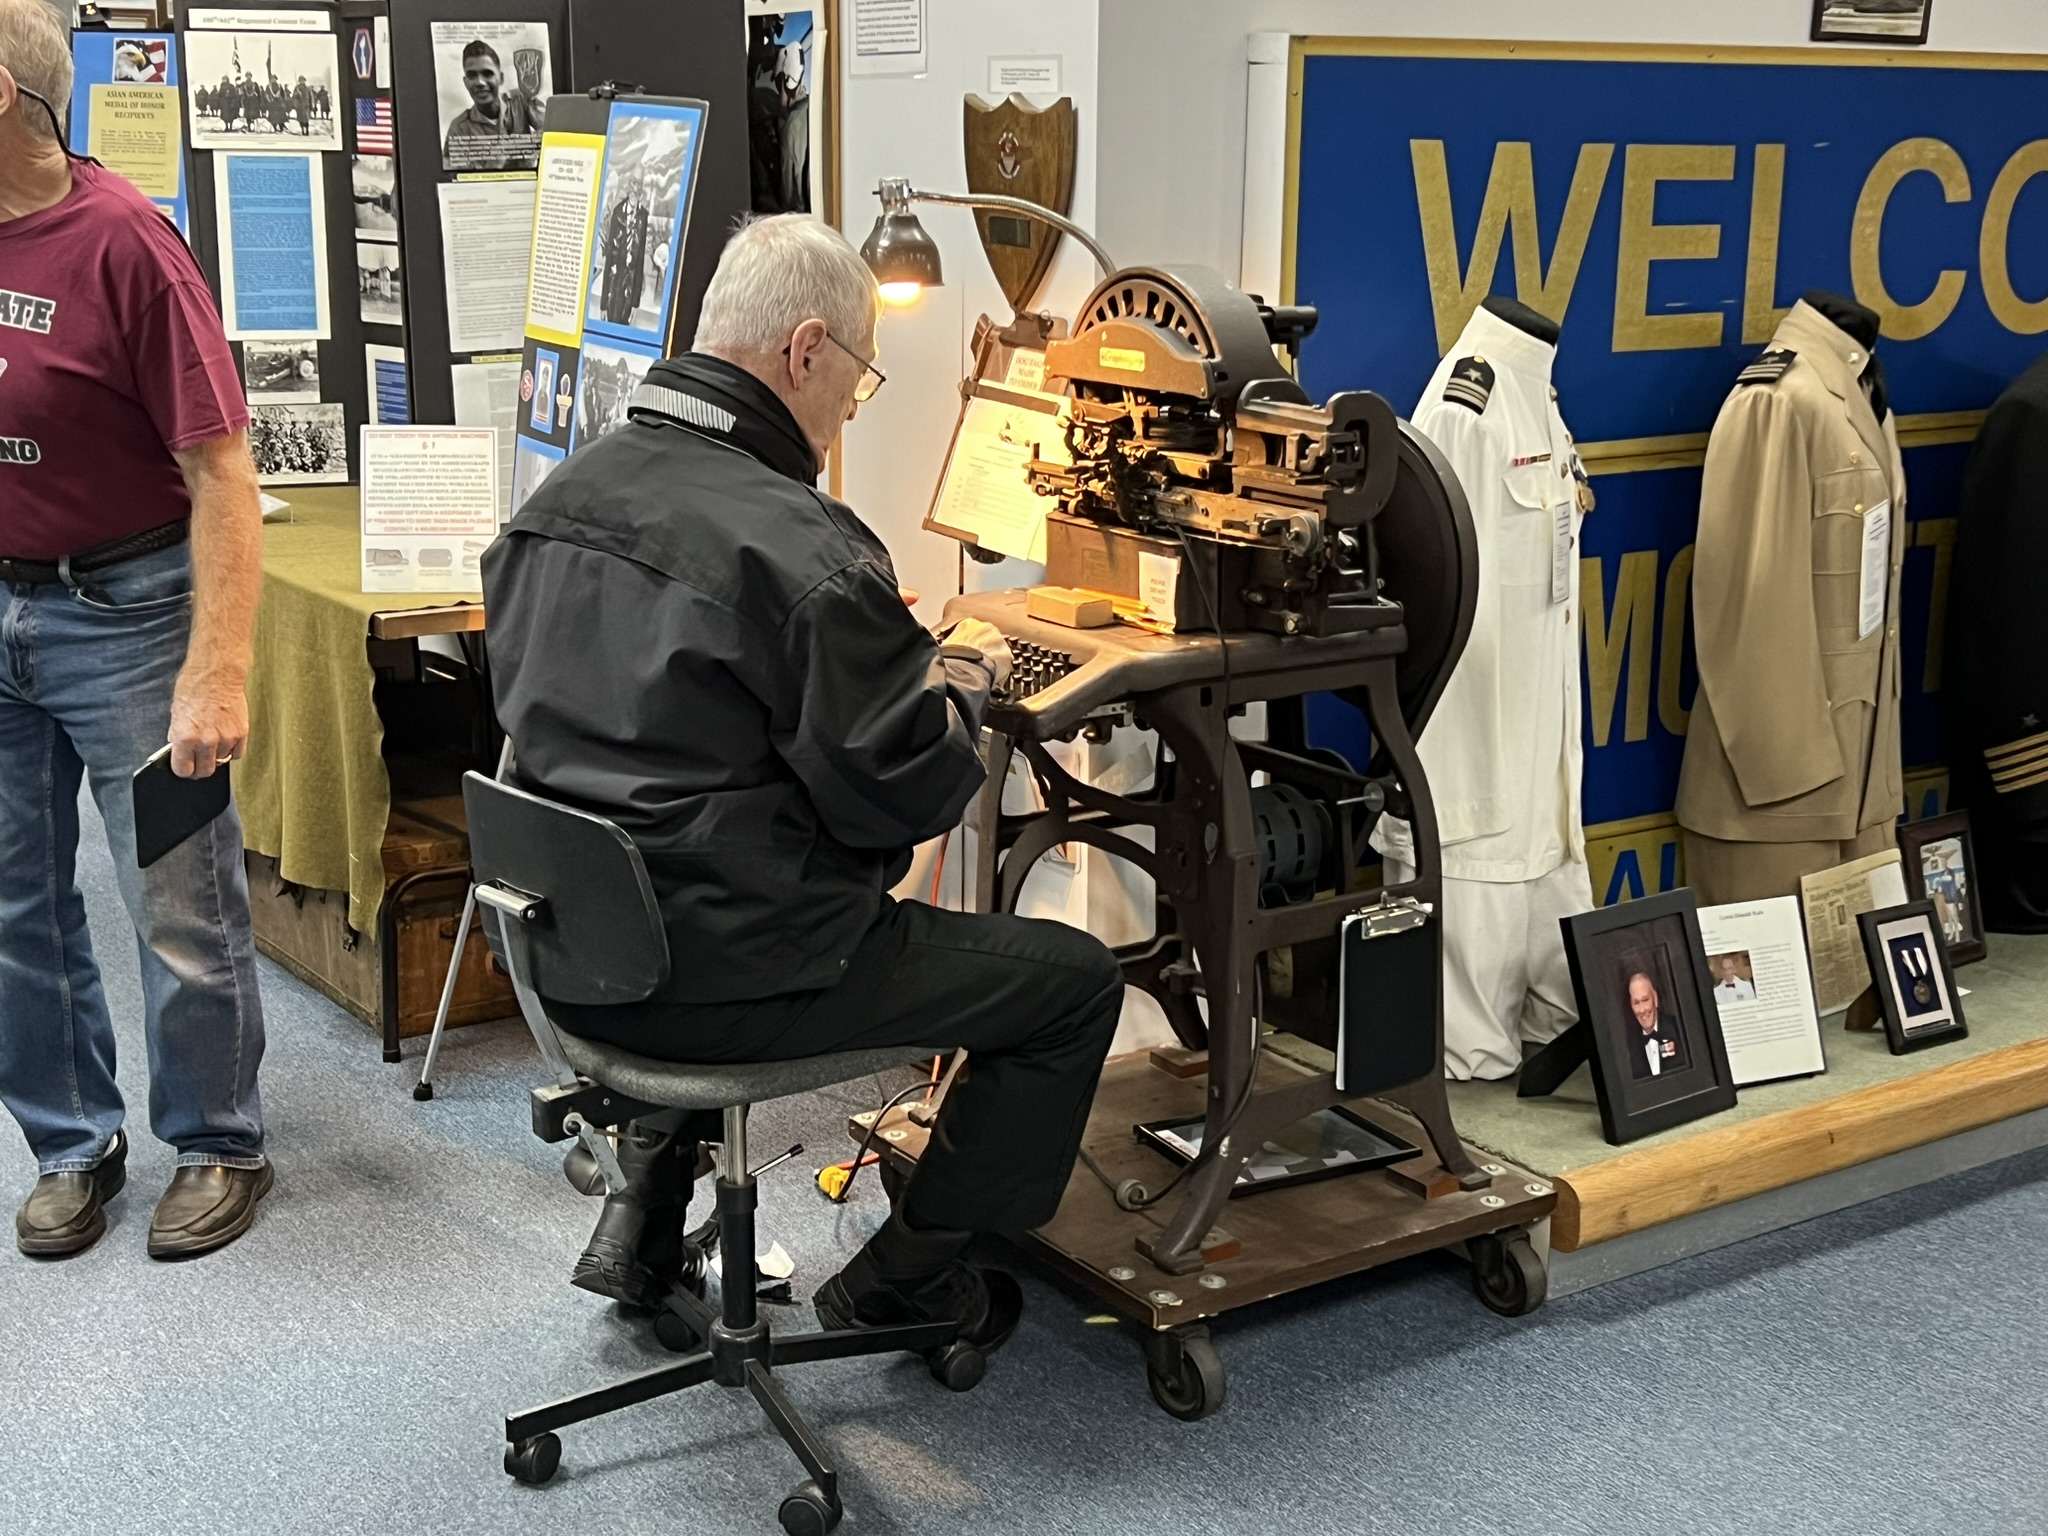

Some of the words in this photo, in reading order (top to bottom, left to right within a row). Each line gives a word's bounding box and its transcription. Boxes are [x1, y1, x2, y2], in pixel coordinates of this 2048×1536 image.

[106, 90, 126, 99] ASIAN
[128, 91, 164, 99] AMERICAN
[105, 101, 128, 109] MEDAL
[114, 111, 155, 120] RECIPIENTS
